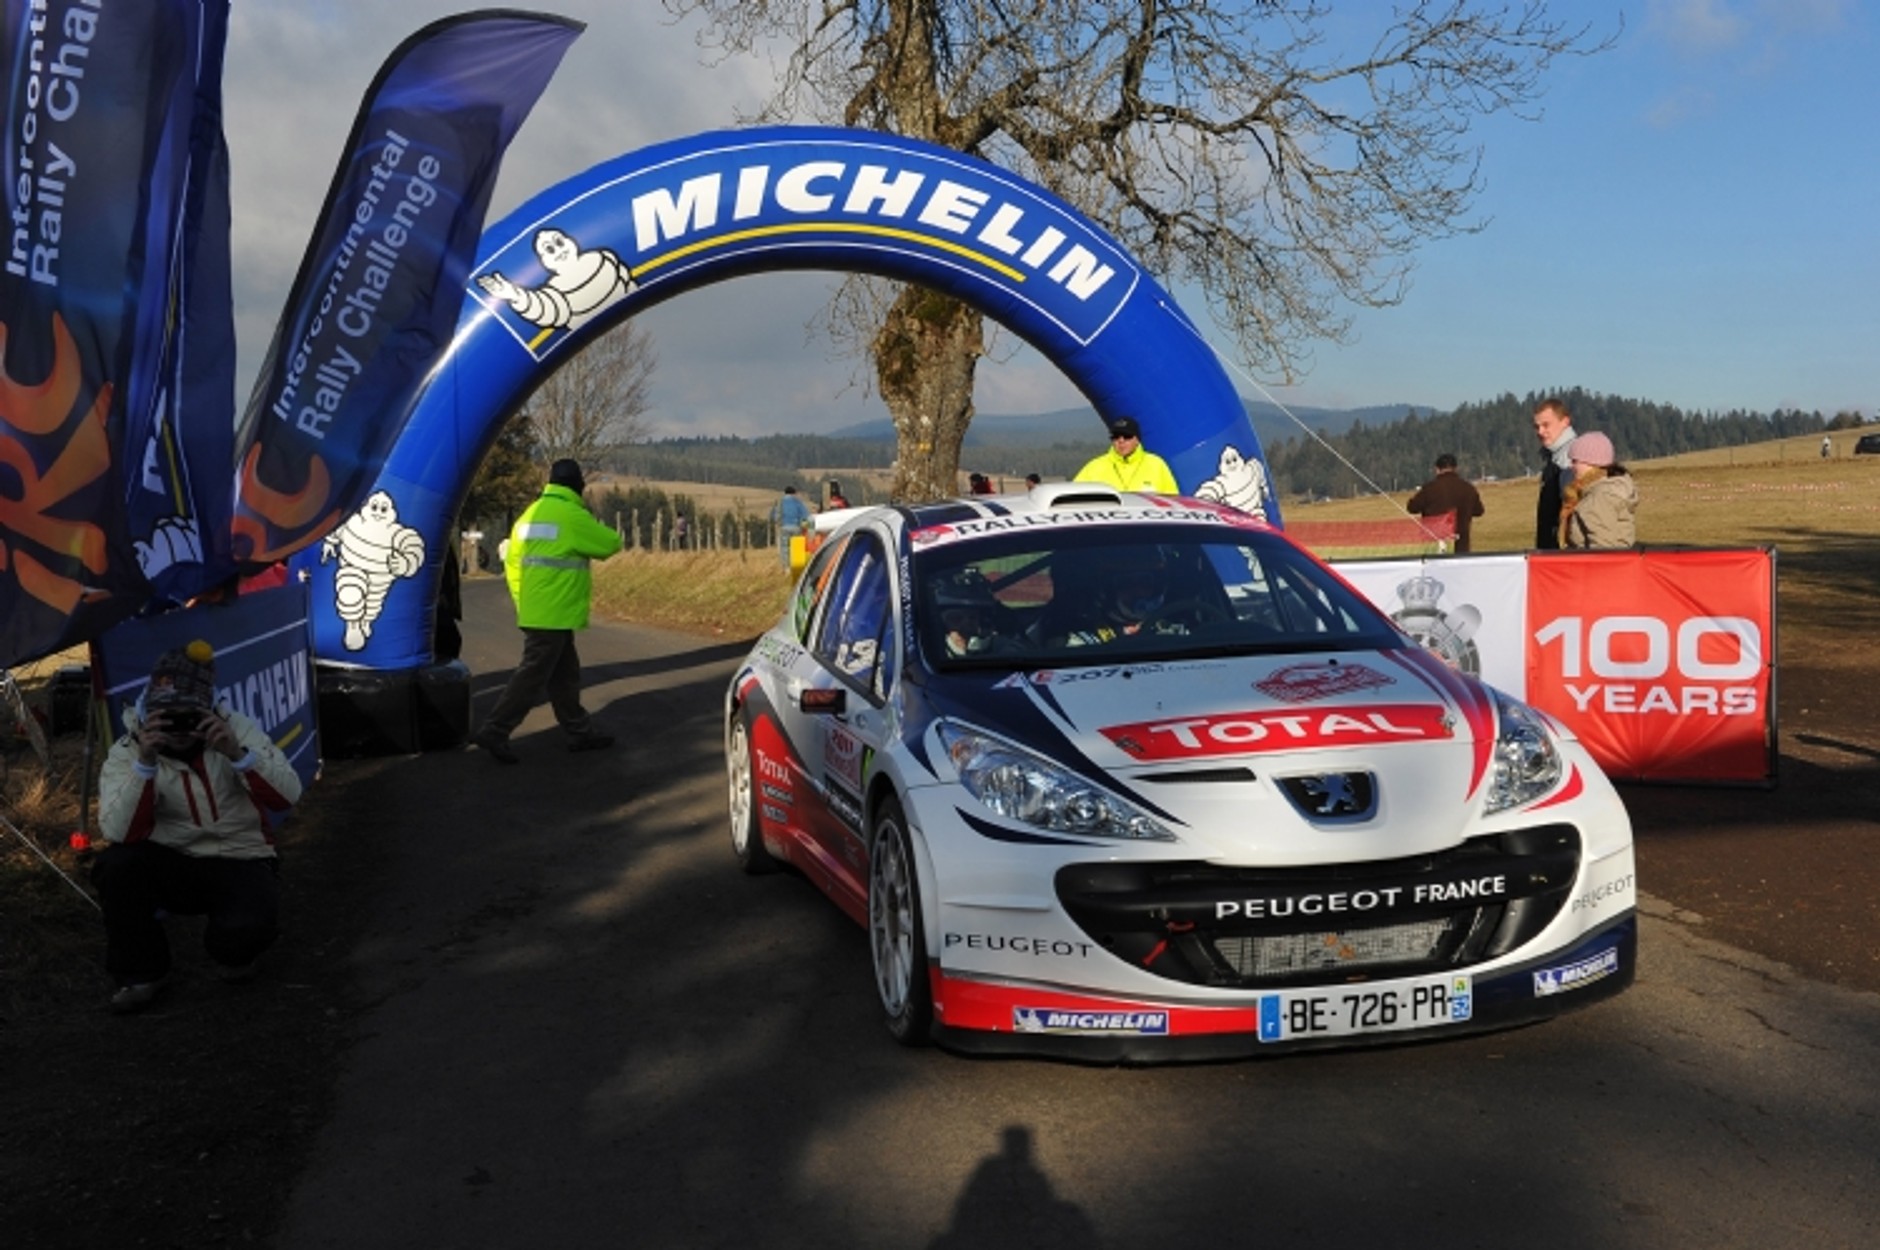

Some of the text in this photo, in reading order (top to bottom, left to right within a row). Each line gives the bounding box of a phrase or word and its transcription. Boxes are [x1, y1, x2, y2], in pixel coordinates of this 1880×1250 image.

[31, 141, 76, 287] Rally
[631, 161, 1114, 301] MICHELIN
[272, 129, 409, 422] Intercontinental
[296, 154, 440, 440] Rally Challenge
[955, 509, 1222, 536] RALLY-IRC.COM
[1534, 616, 1762, 680] 100
[1564, 684, 1757, 715] YEARS
[1149, 712, 1426, 749] TOTAL
[1216, 876, 1506, 919] PEUGEOT FRANCE
[945, 933, 1094, 958] PEUGEOT
[1047, 1012, 1165, 1030] MICHELIN
